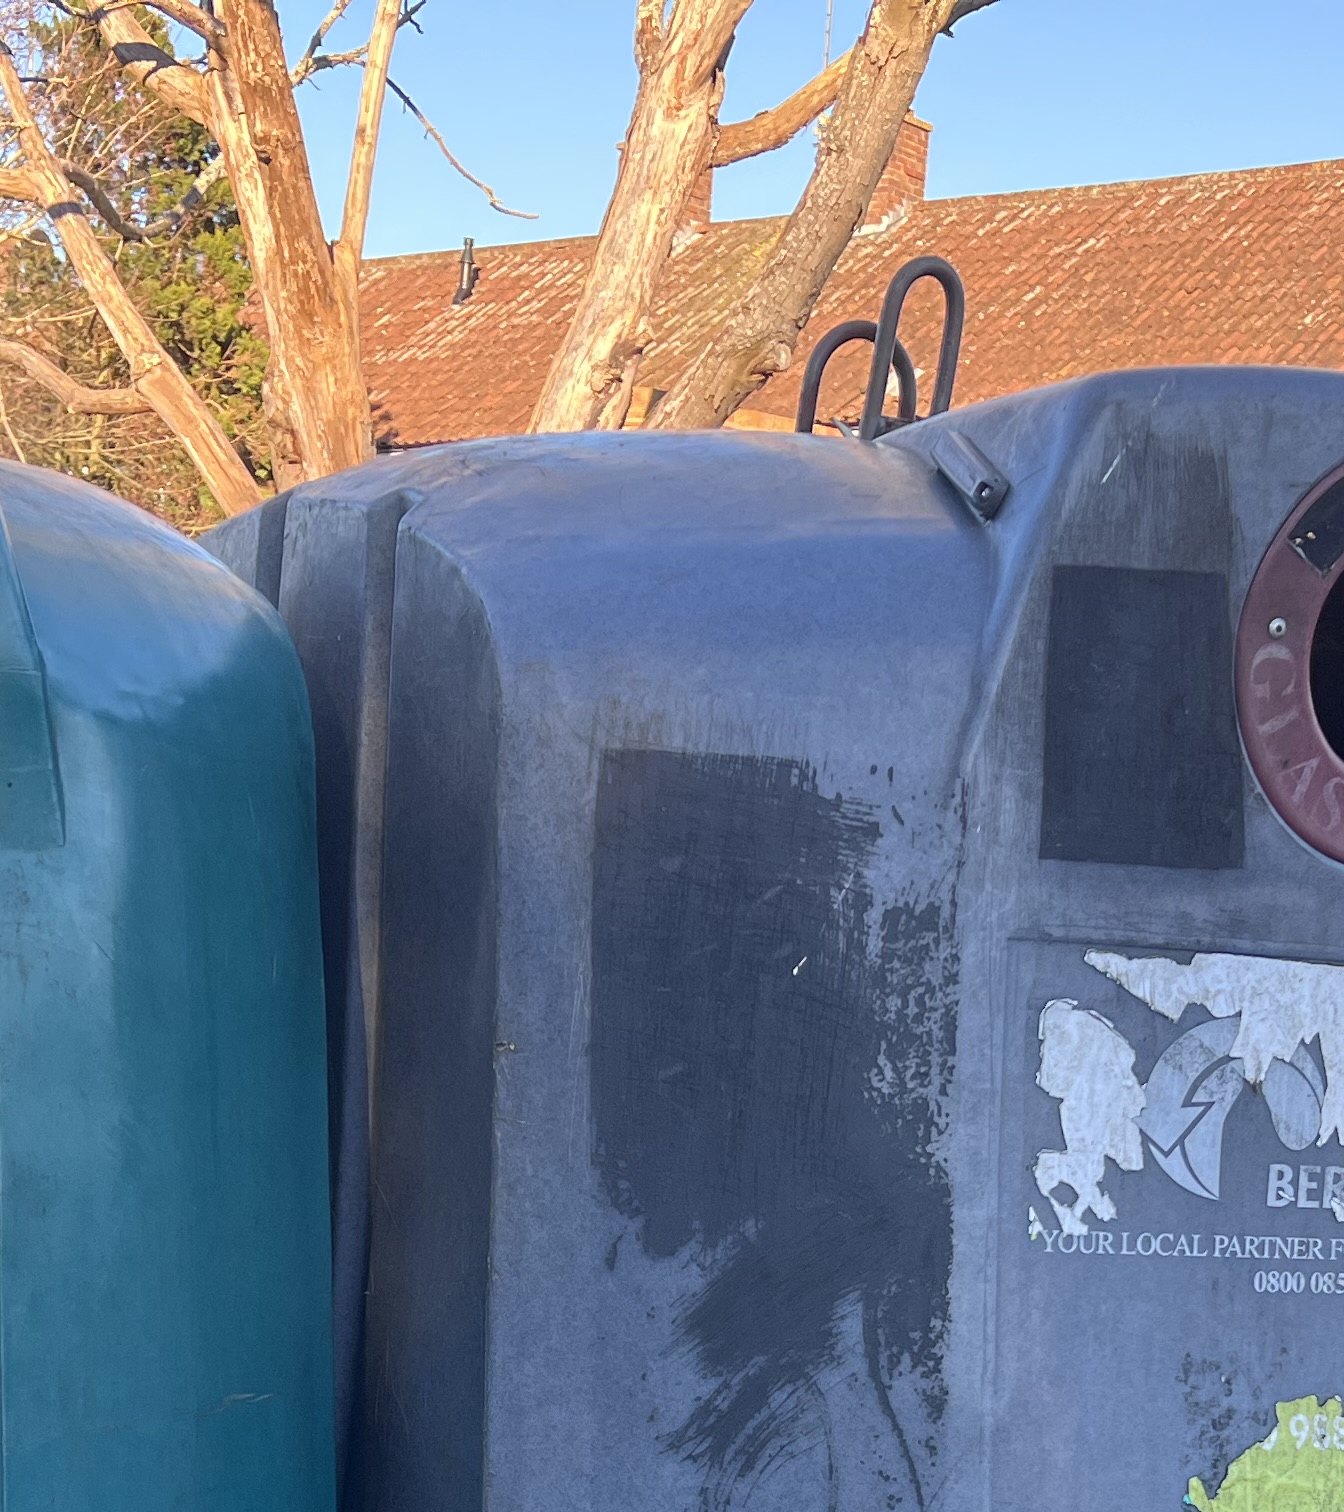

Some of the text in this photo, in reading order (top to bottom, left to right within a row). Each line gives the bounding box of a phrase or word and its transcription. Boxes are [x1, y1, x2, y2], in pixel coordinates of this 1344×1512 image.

[1040, 1229, 1115, 1255] YOUR
[1119, 1231, 1209, 1258] LOCAL
[1212, 1233, 1324, 1261] PARTNER
[1253, 1270, 1305, 1294] 0800
